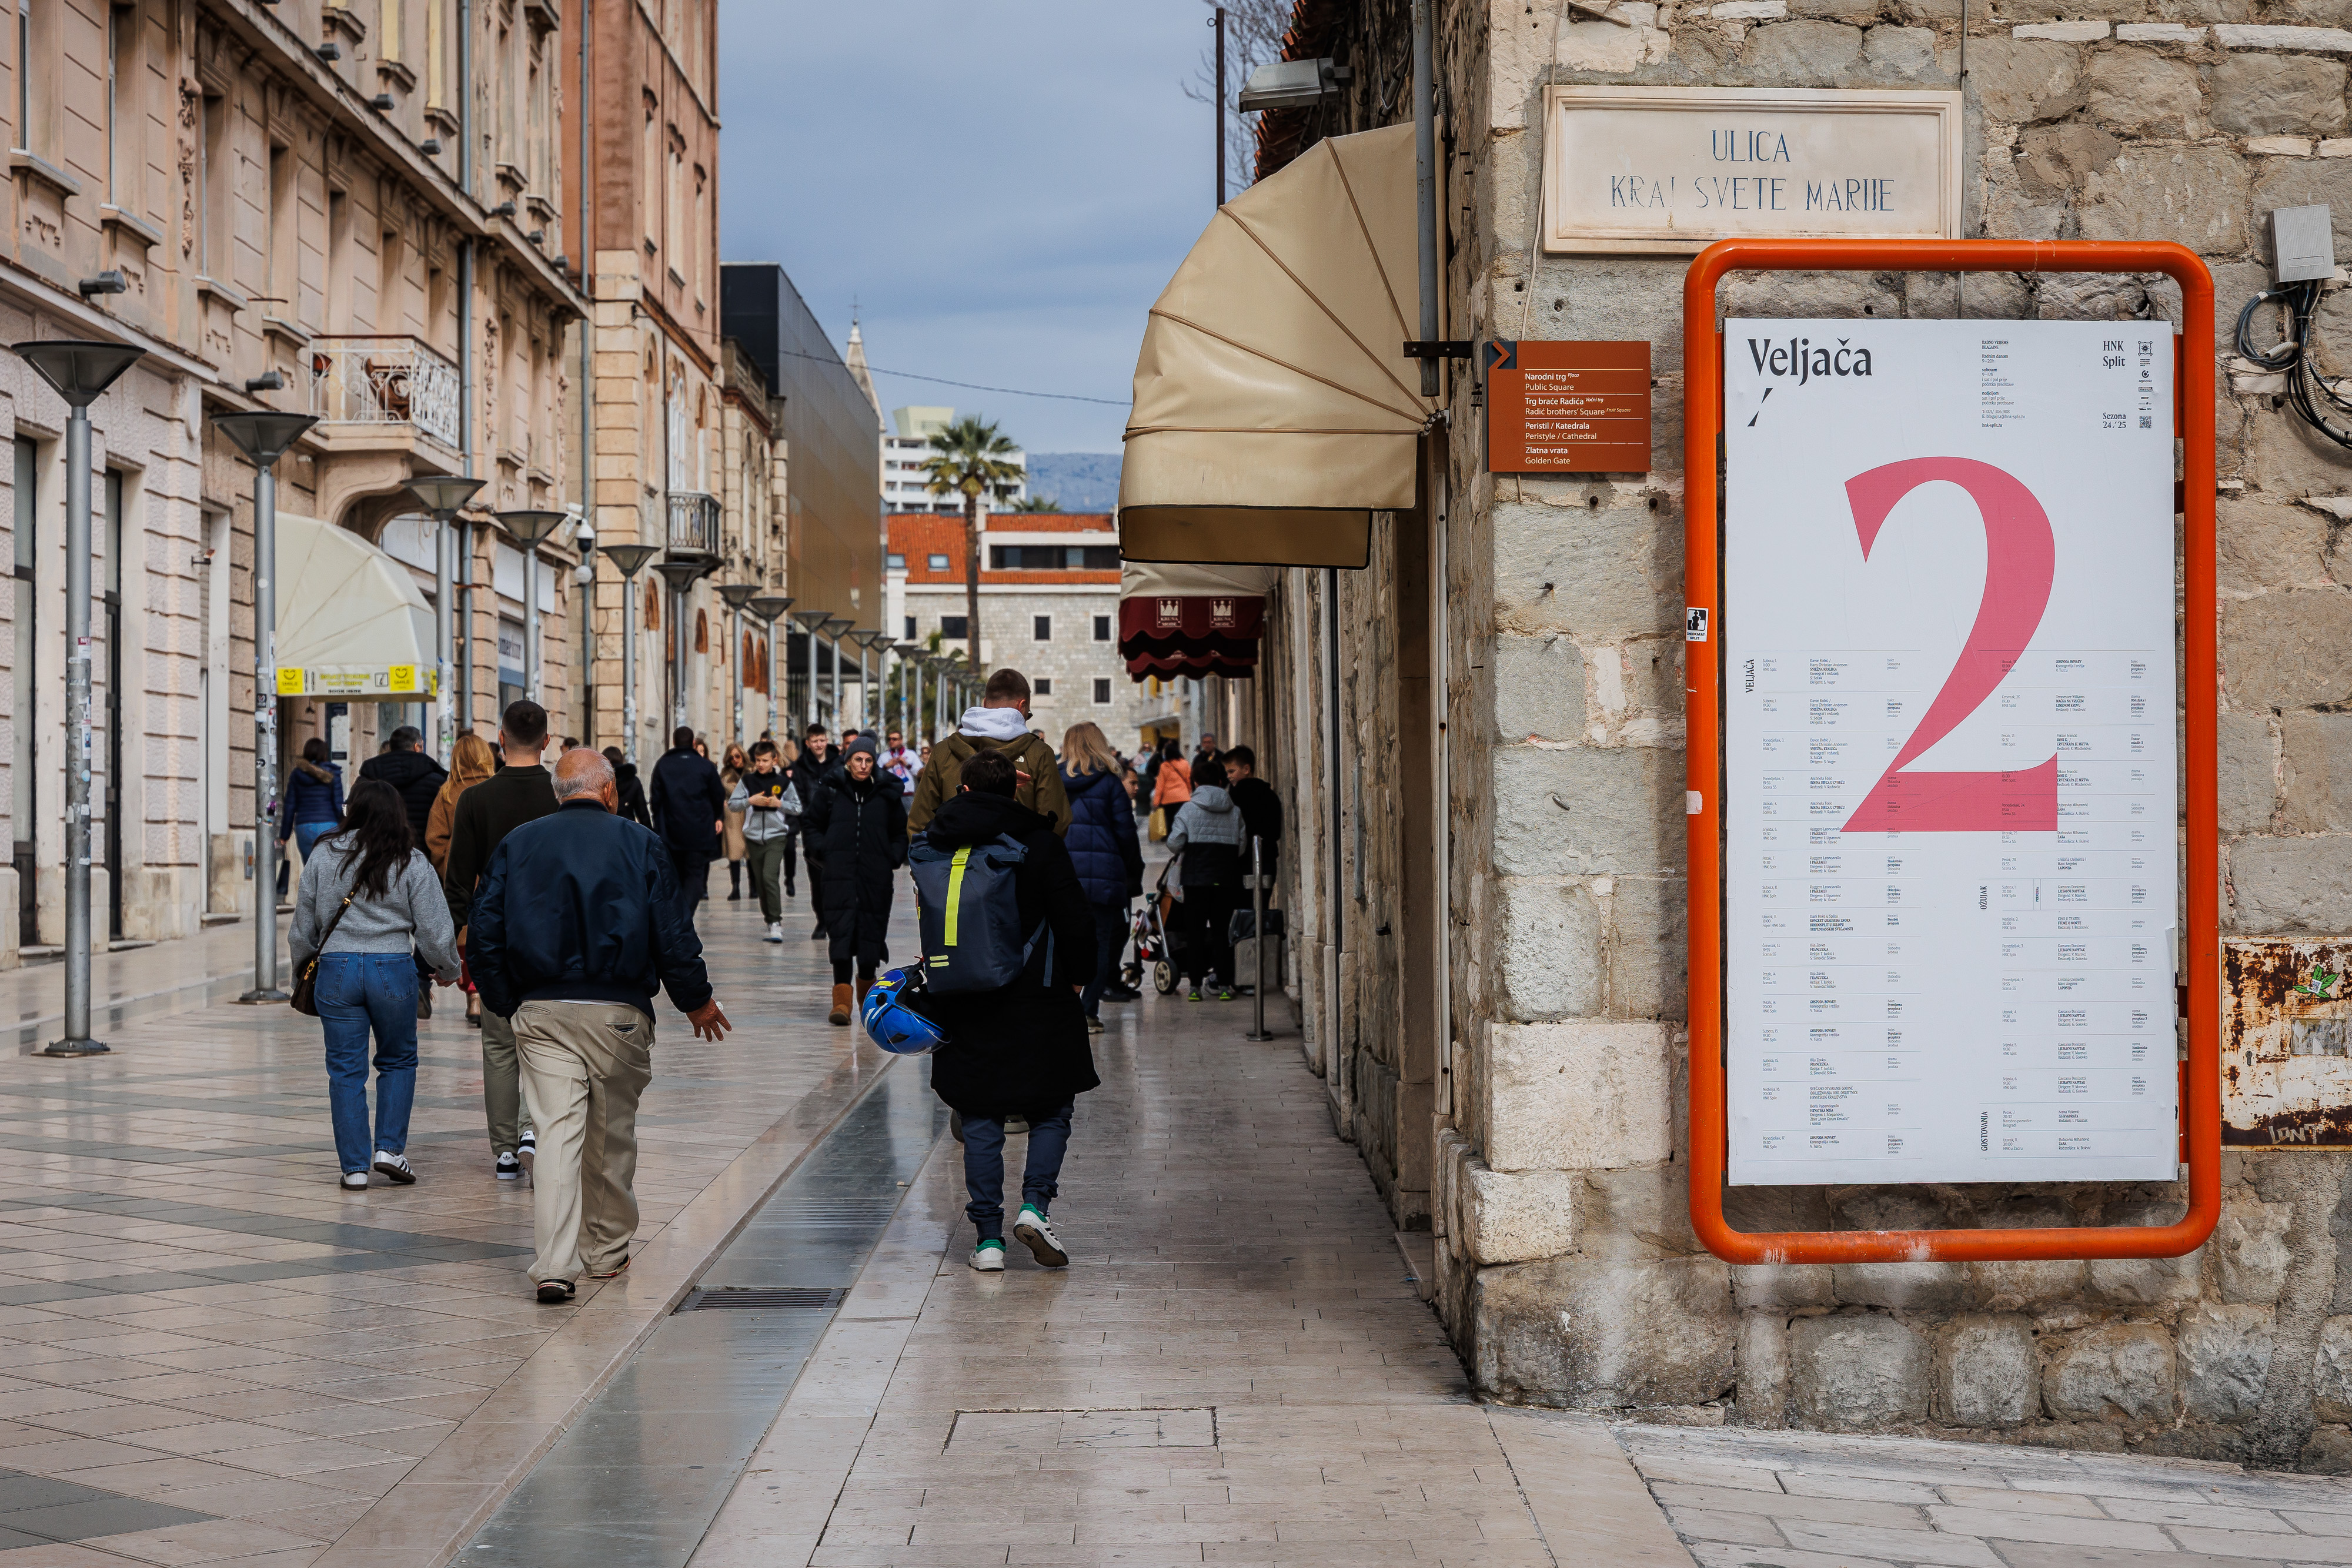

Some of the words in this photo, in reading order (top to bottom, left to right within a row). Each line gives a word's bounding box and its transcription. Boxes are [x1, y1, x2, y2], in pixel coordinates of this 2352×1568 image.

[1712, 129, 1791, 163] ULICA
[1611, 175, 1675, 209] KRAJ
[1696, 177, 1787, 210] SVETE
[1806, 179, 1896, 212] MARIJE
[2103, 341, 2124, 352] HNK
[1748, 337, 1872, 386] Veljača
[2103, 356, 2126, 369] Split
[1556, 374, 1566, 382] trg
[1549, 383, 1574, 392] Square
[1525, 398, 1536, 407] Trg
[1525, 433, 1556, 442] Peristyle
[1840, 457, 2057, 831] 2
[1744, 658, 1755, 694] VELJAČA
